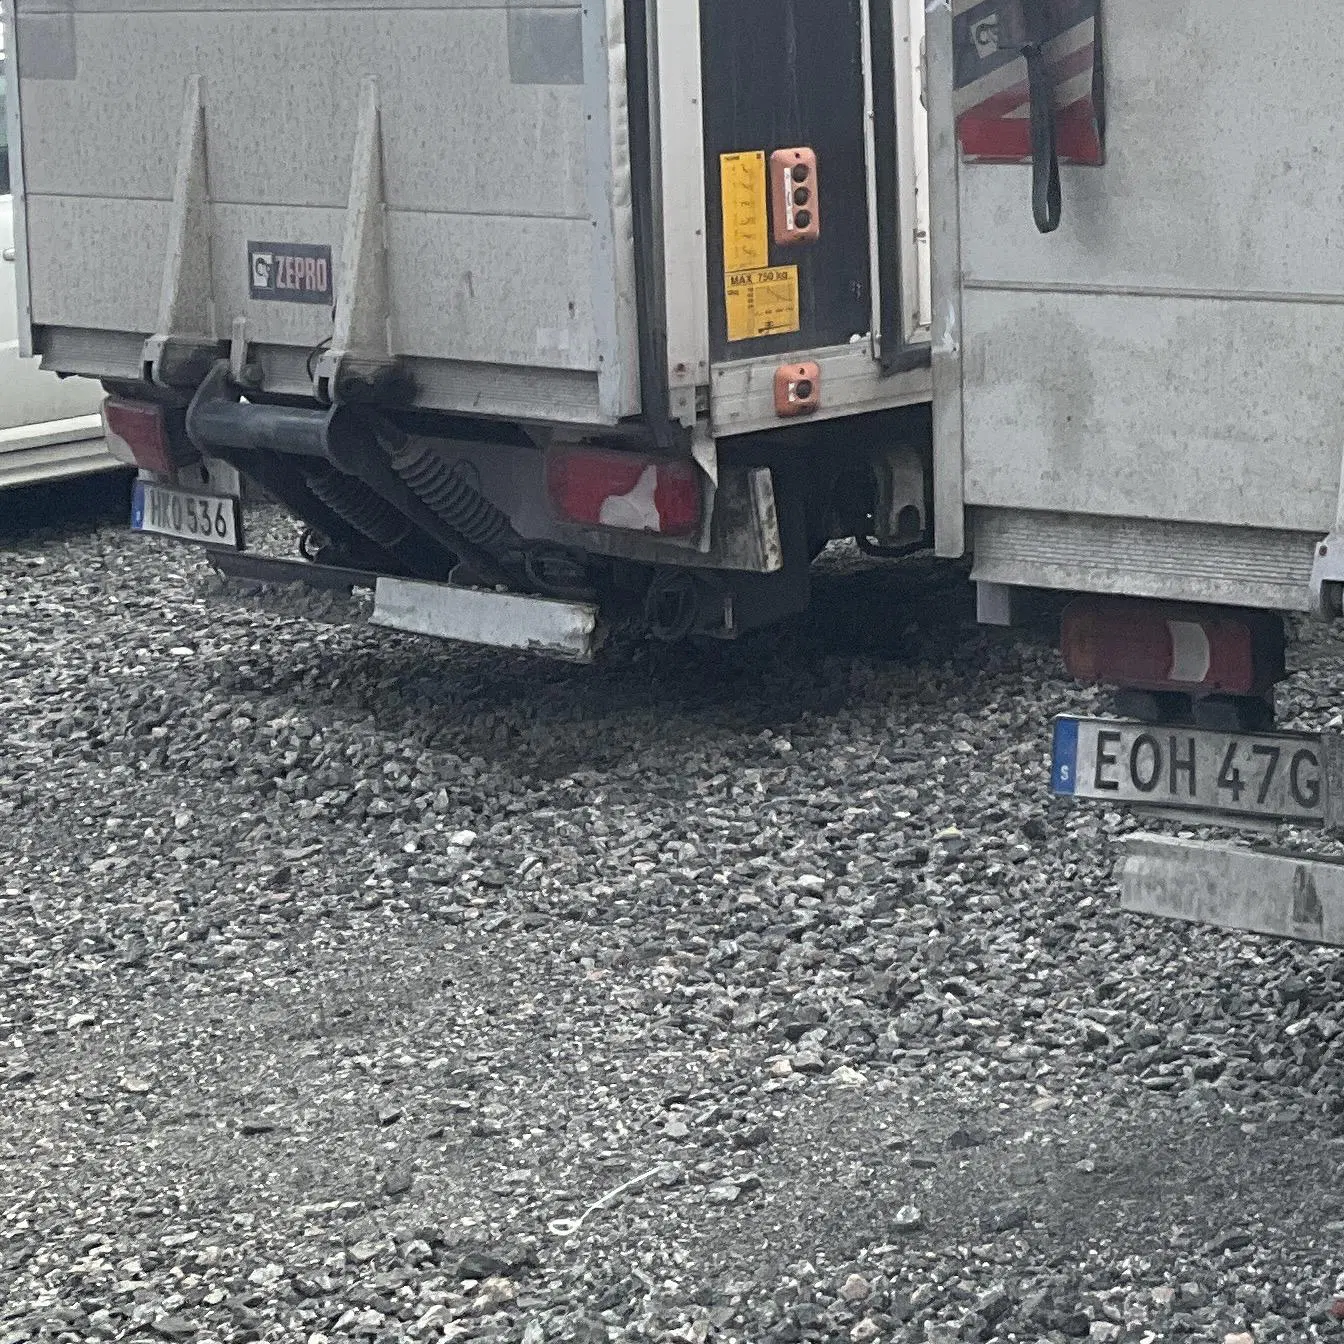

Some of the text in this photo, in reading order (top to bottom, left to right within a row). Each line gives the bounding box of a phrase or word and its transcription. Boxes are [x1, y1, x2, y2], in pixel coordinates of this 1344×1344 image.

[275, 255, 328, 292] ZEPRO
[730, 274, 753, 286] MAX
[186, 497, 227, 538] 536
[1060, 729, 1320, 808] S EOH 47G
